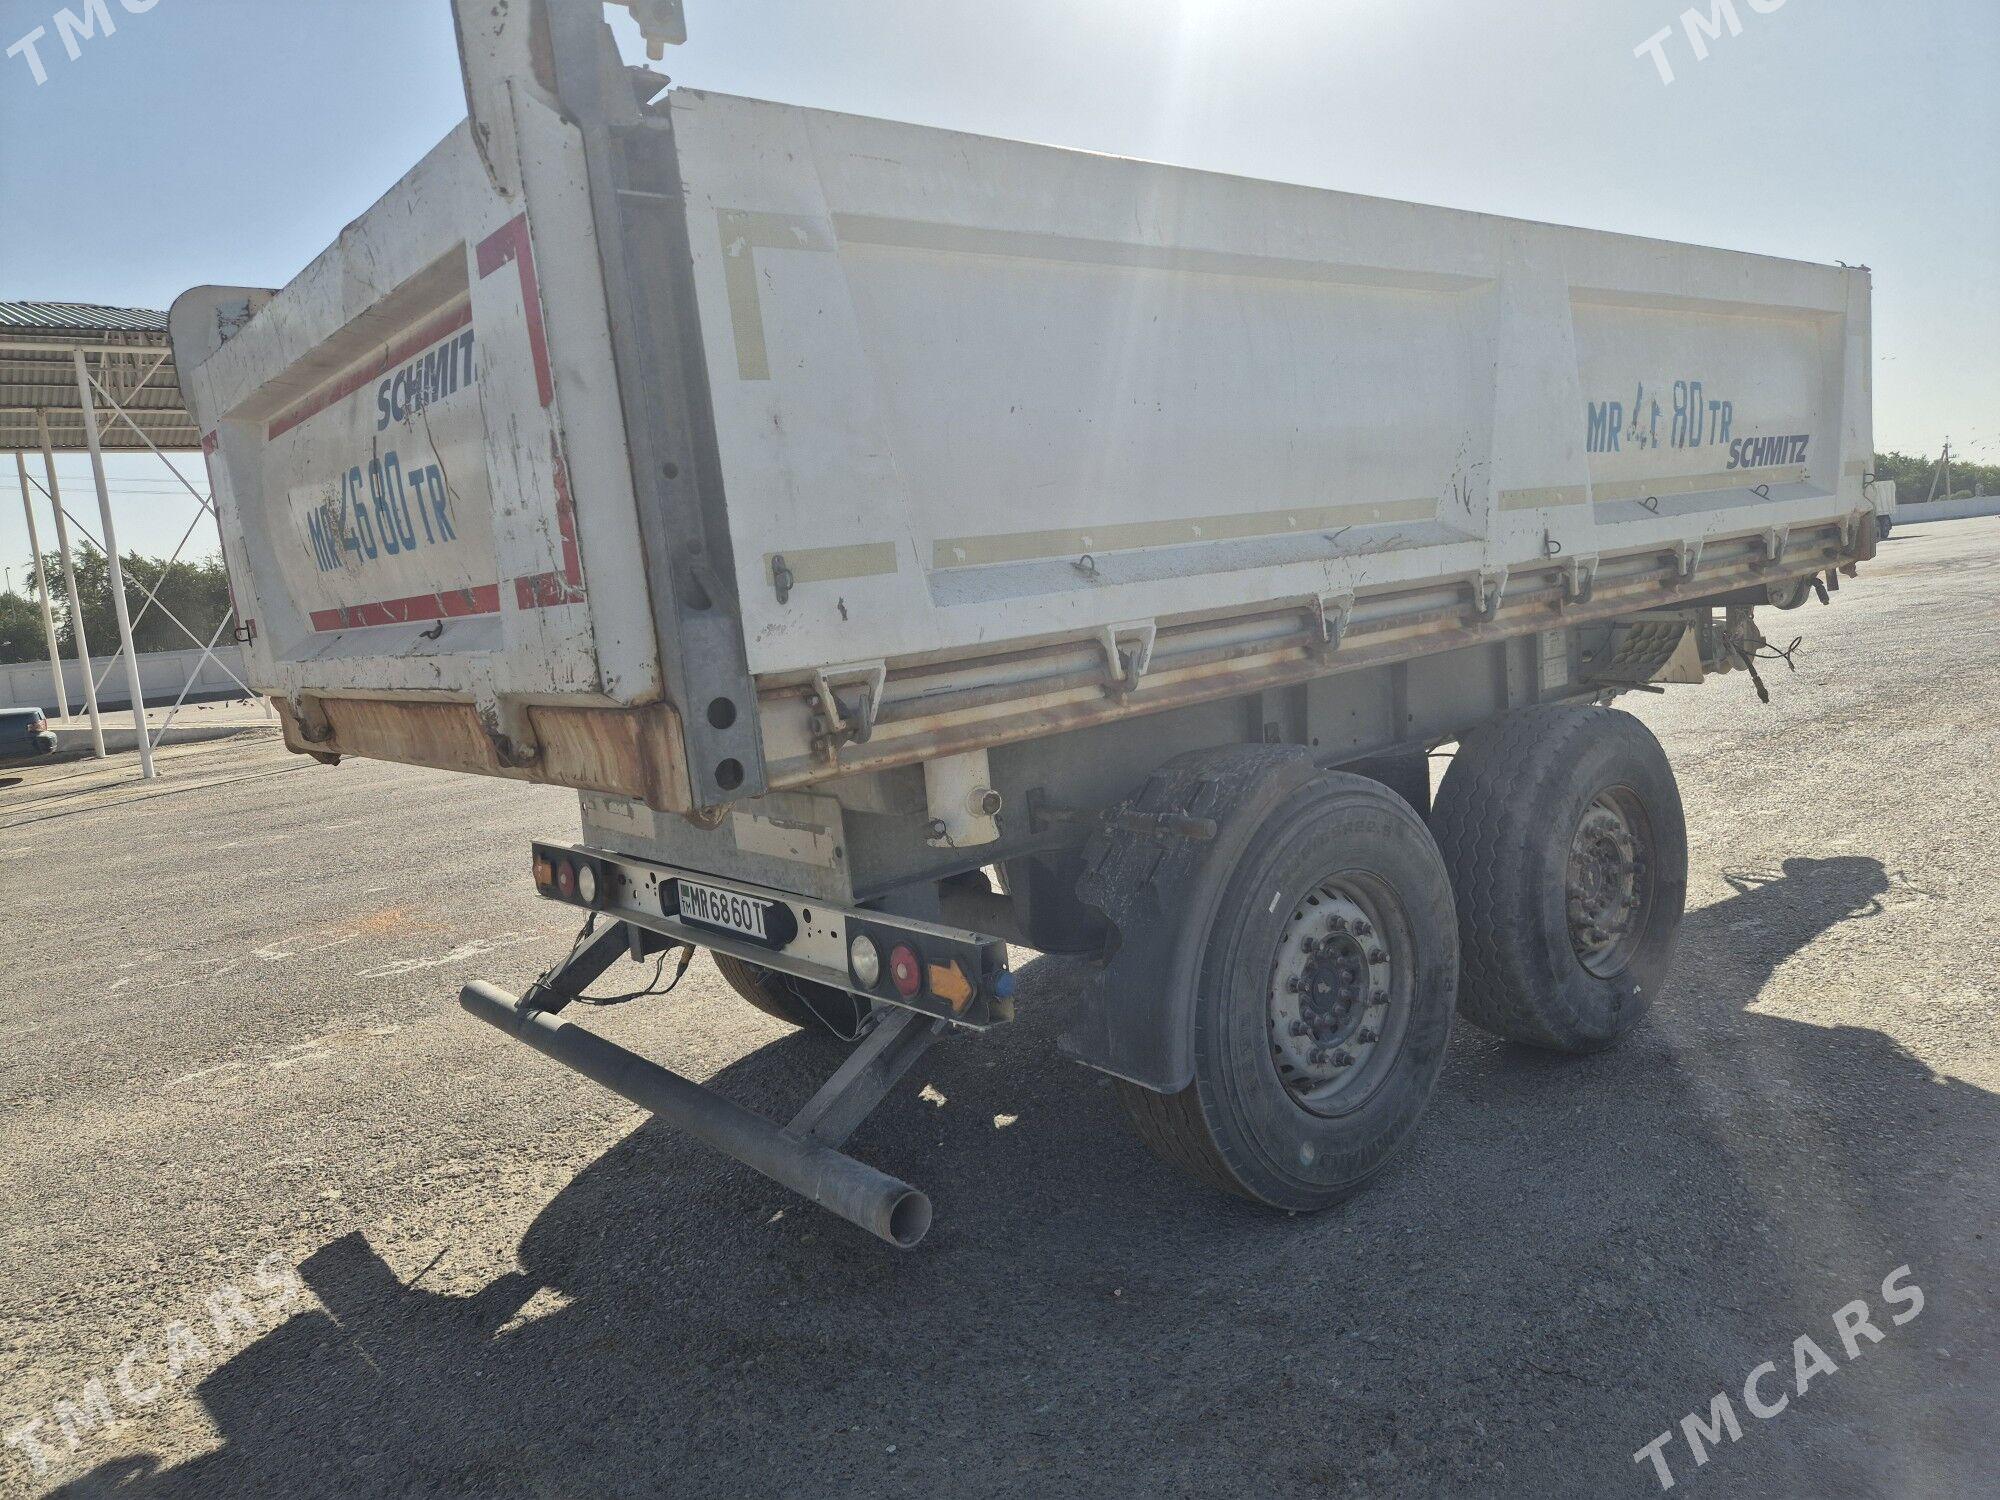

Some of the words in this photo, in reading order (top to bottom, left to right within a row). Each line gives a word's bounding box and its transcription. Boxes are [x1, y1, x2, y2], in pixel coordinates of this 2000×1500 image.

[377, 328, 478, 431] SCHMIT
[1586, 401, 1623, 452] MR
[1708, 400, 1733, 445] TR
[1726, 434, 1810, 469] SCHMITZ
[339, 450, 417, 565] 4680
[408, 464, 457, 545] TR
